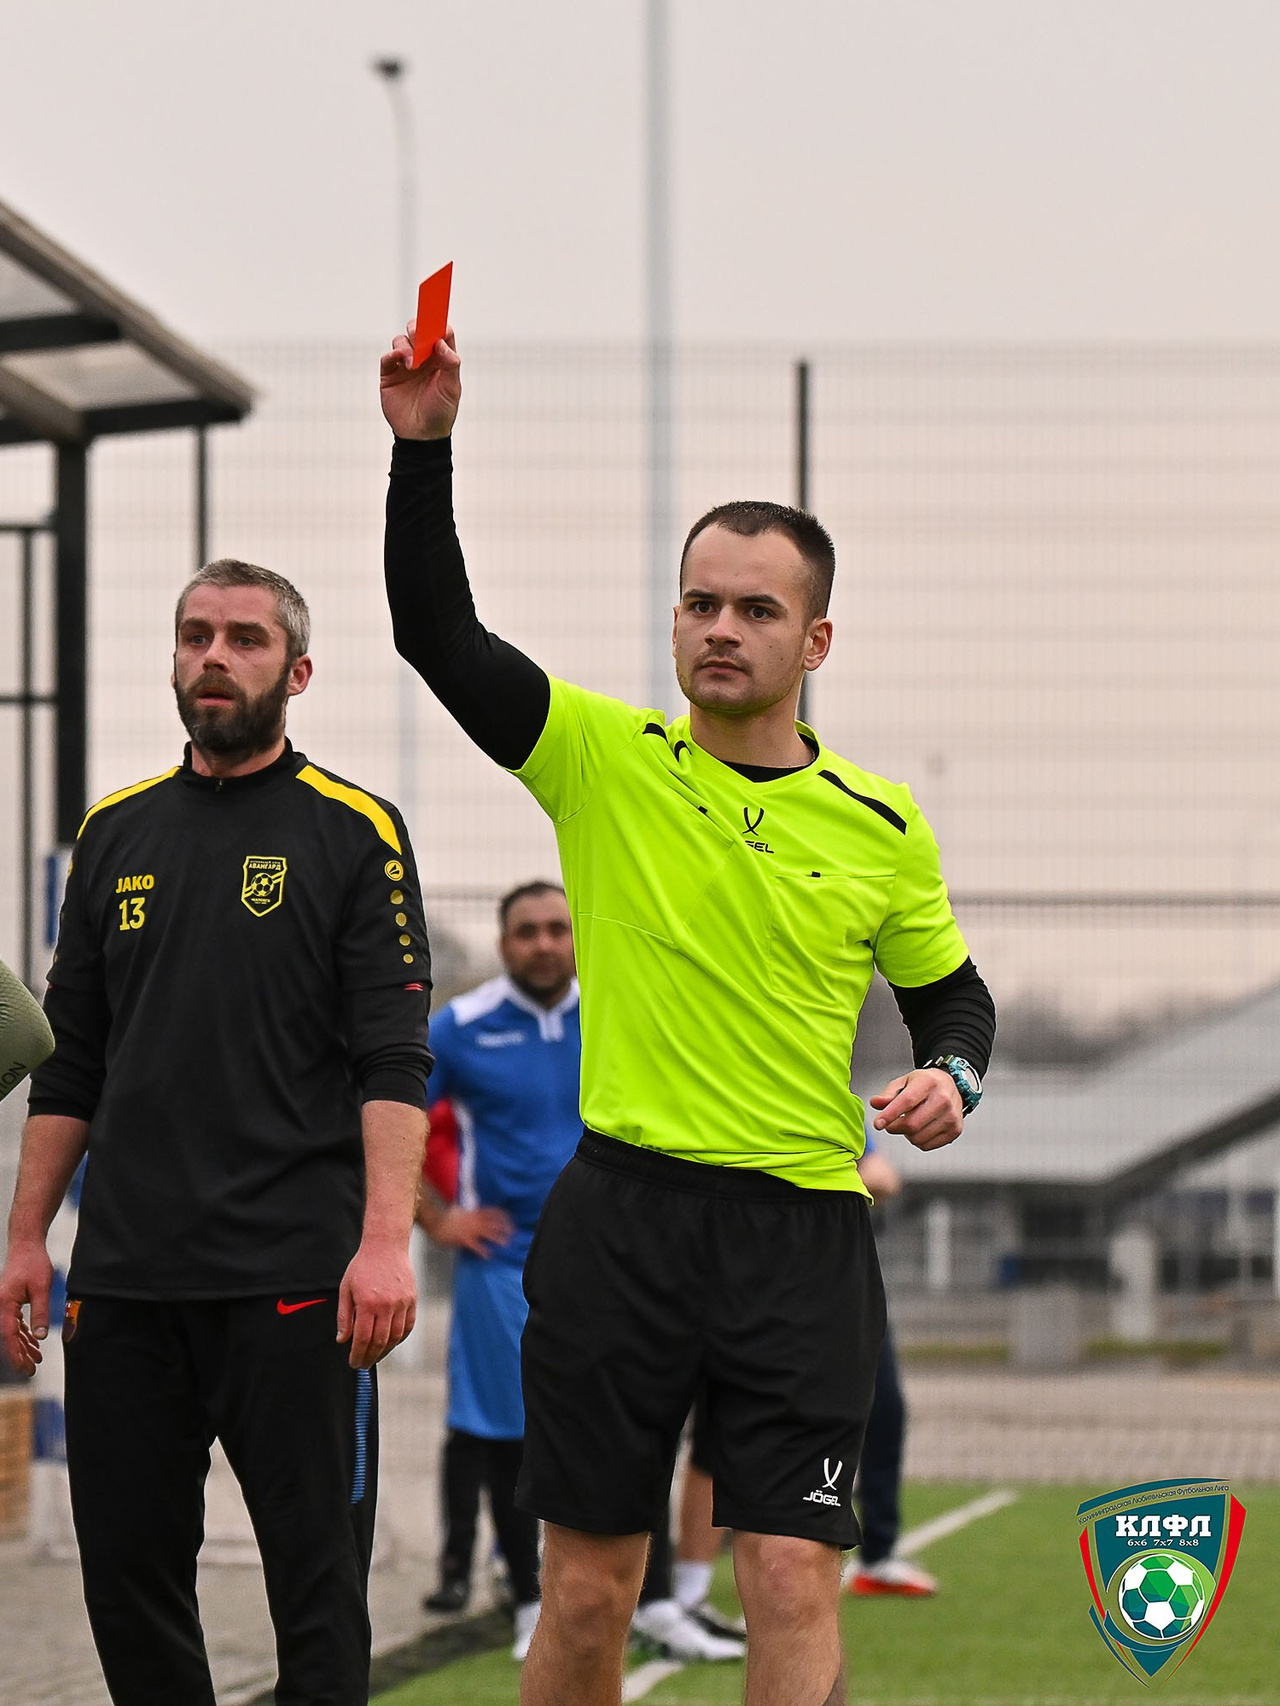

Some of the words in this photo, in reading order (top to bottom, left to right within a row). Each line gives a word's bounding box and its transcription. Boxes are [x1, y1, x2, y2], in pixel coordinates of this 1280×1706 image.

[115, 874, 156, 894] JAKO
[118, 896, 147, 932] 13
[802, 1489, 842, 1507] JÖGEL
